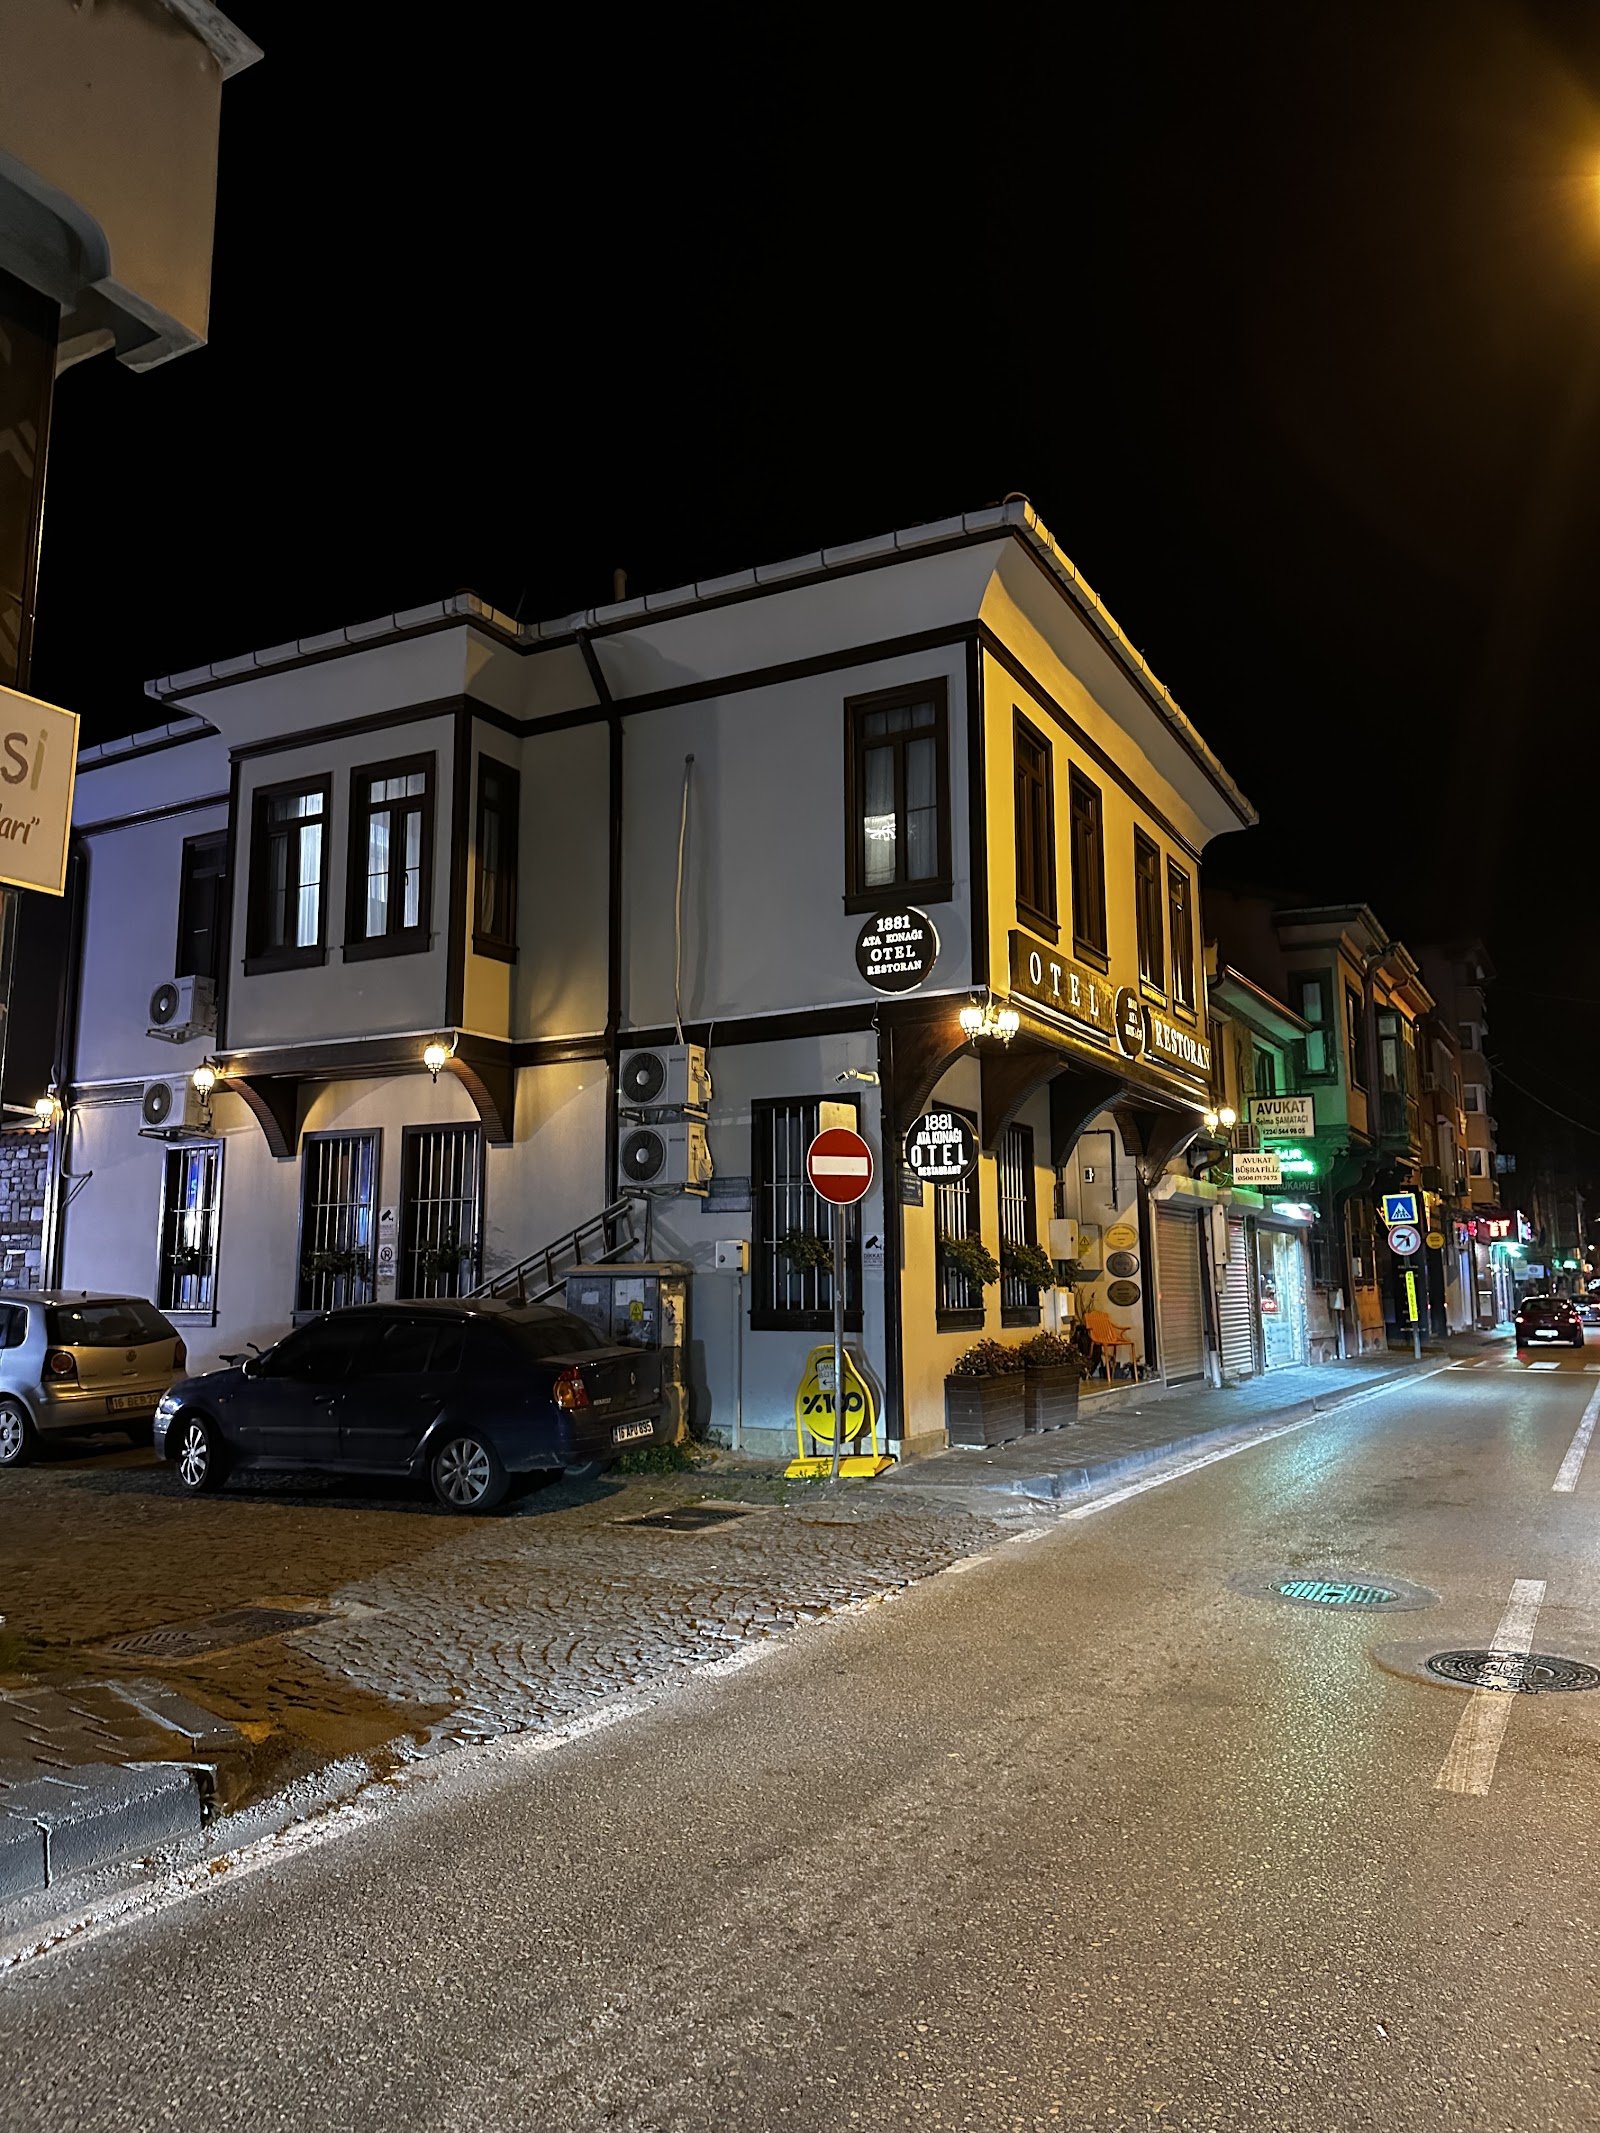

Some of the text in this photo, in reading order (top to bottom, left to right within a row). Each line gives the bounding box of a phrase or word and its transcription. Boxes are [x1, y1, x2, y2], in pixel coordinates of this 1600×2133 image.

[877, 915, 911, 933] 1881
[862, 929, 923, 947] ATA KONAĞI
[870, 945, 916, 962] OTEL
[867, 960, 923, 976] RESTORAN
[1029, 951, 1099, 1017] OTEL
[1154, 1019, 1210, 1071] RESTORAN
[1256, 1100, 1306, 1115] AVUKAT
[924, 1113, 953, 1131] 1881
[1256, 1117, 1274, 1126] Selma
[916, 1128, 962, 1146] ATA KONAĞI
[910, 1143, 968, 1167] OTEL
[1235, 1165, 1260, 1174] BÜŞRA
[1261, 1165, 1280, 1173] FİLİZ
